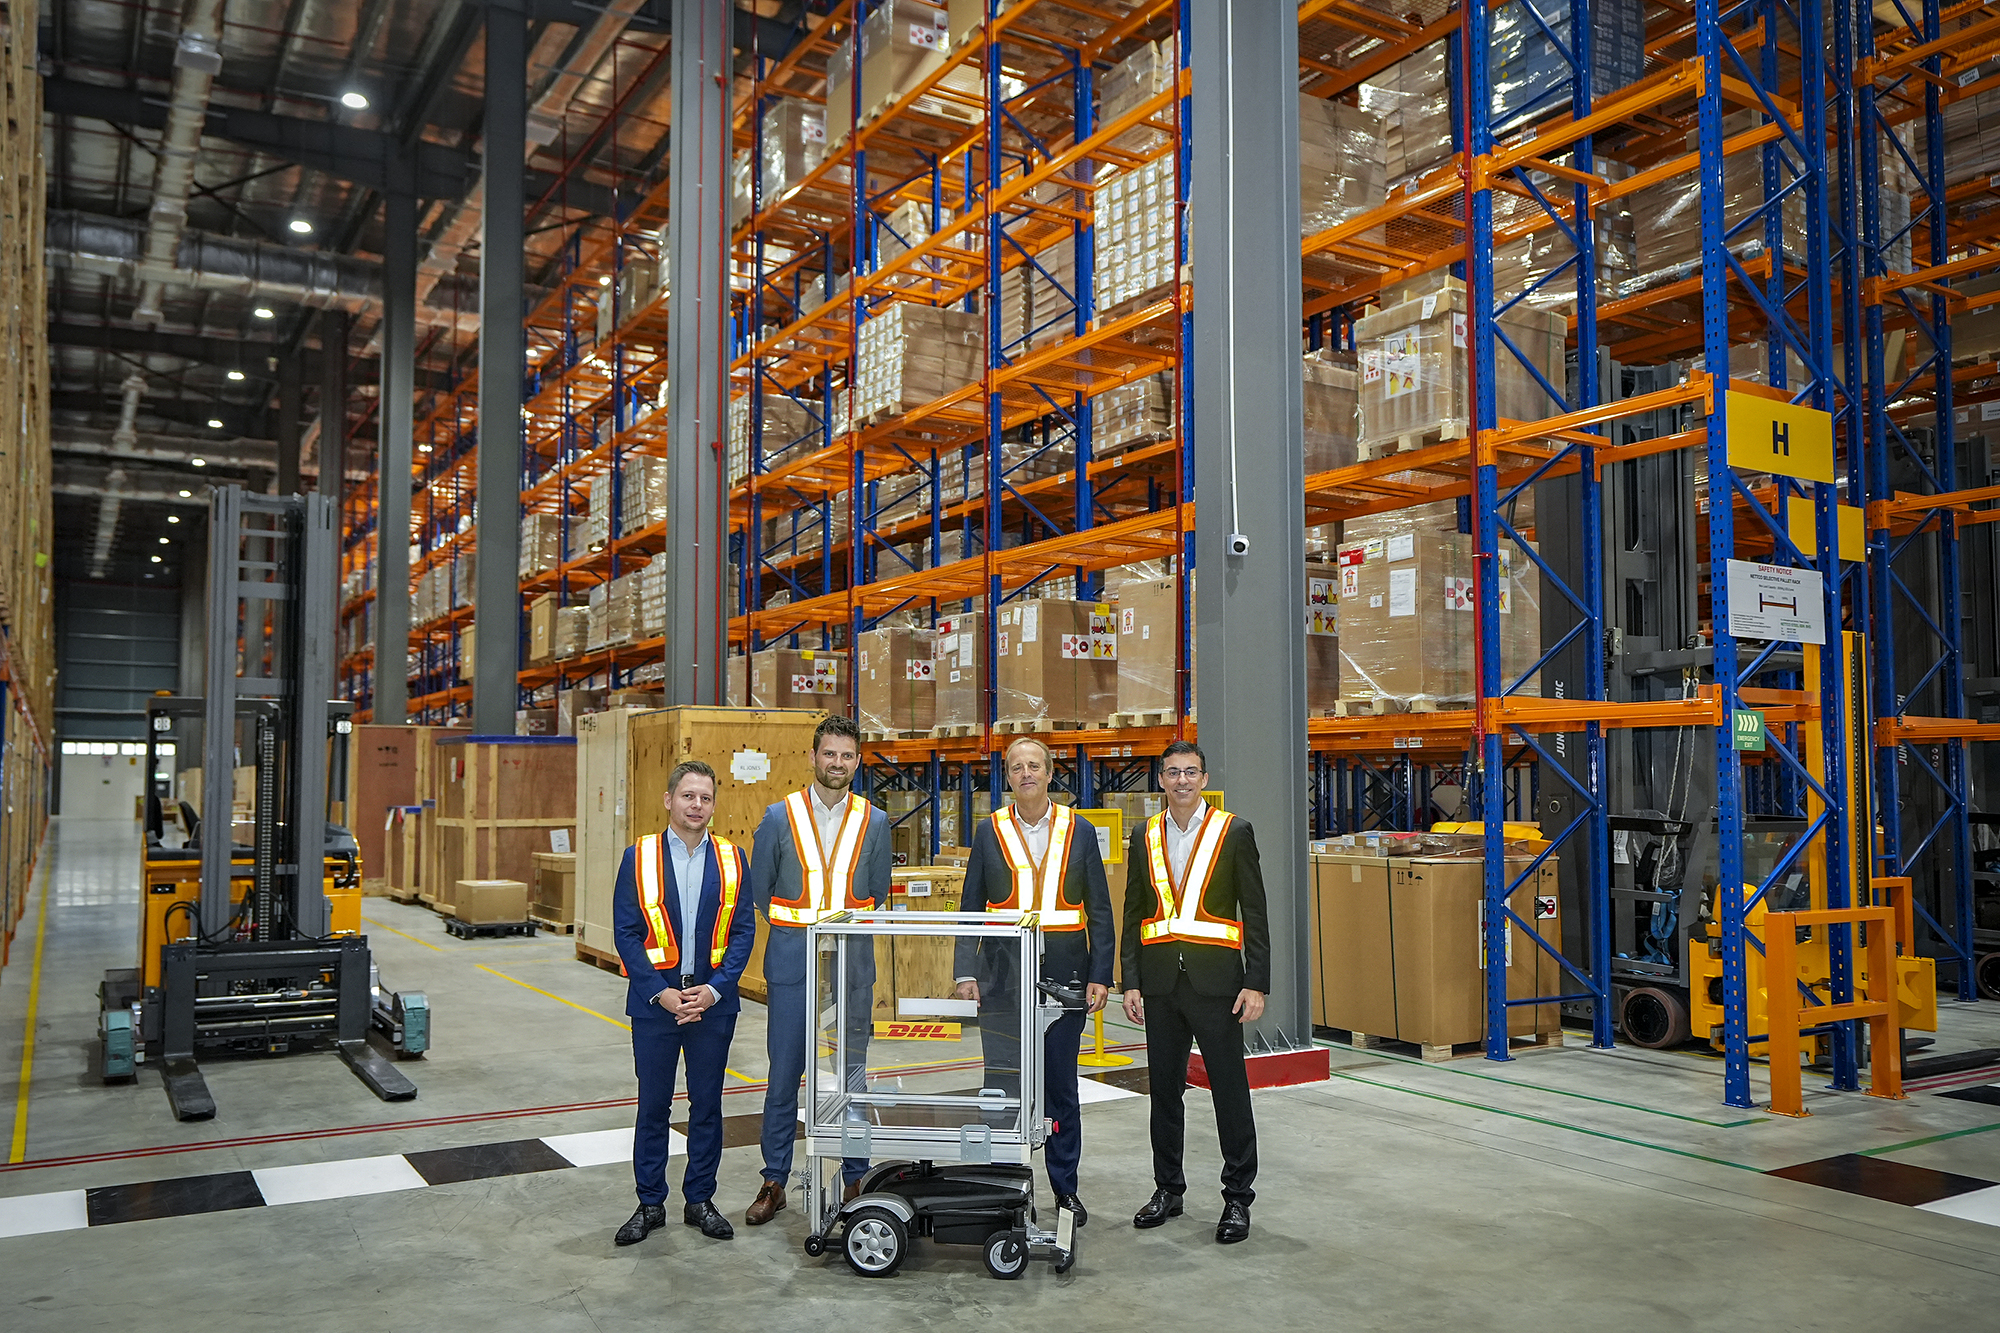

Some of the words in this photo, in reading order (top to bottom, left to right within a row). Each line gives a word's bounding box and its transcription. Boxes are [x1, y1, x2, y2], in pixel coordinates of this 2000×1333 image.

[1772, 420, 1789, 456] H
[1758, 565, 1775, 573] SAFETY
[1776, 567, 1792, 575] NOTICE
[887, 1024, 948, 1038] DHL
